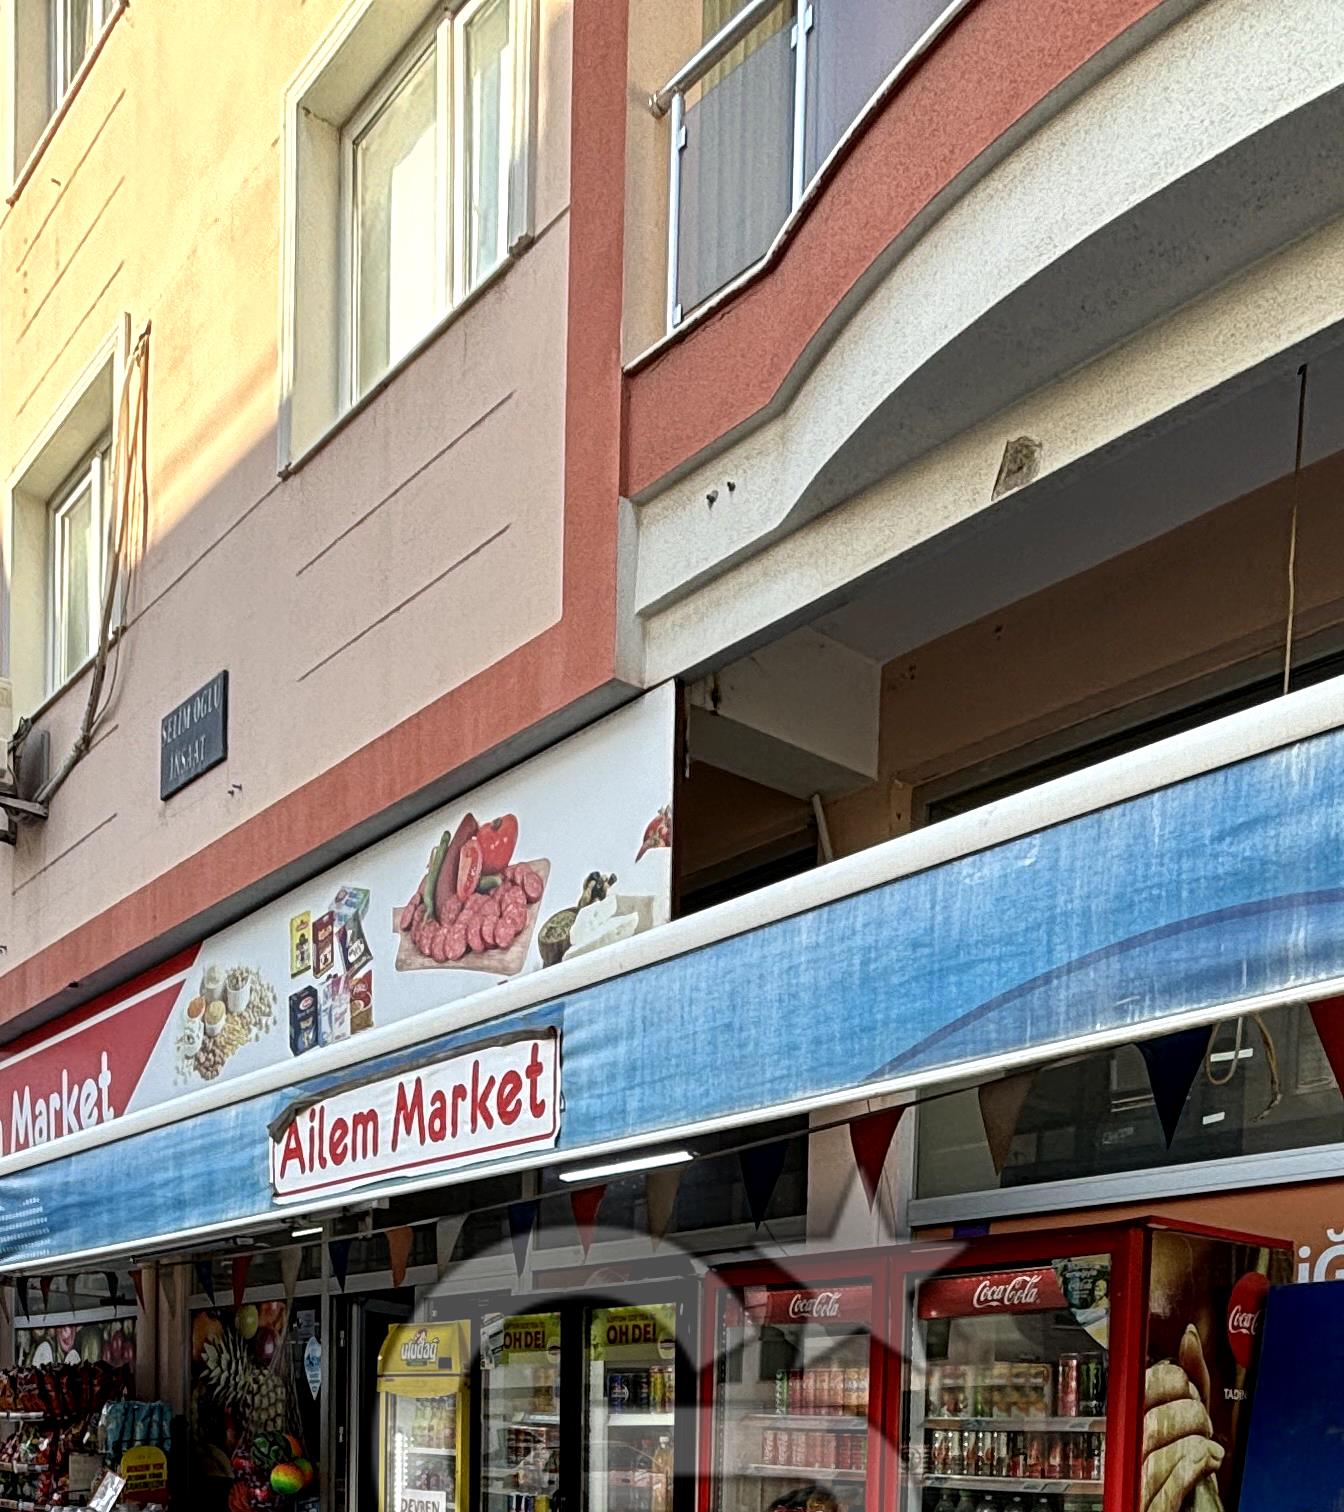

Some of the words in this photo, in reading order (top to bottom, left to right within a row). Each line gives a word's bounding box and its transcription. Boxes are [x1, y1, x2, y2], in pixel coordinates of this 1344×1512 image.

[11, 1050, 115, 1154] Market
[279, 1105, 379, 1180] Ailem
[391, 1042, 546, 1153] Market
